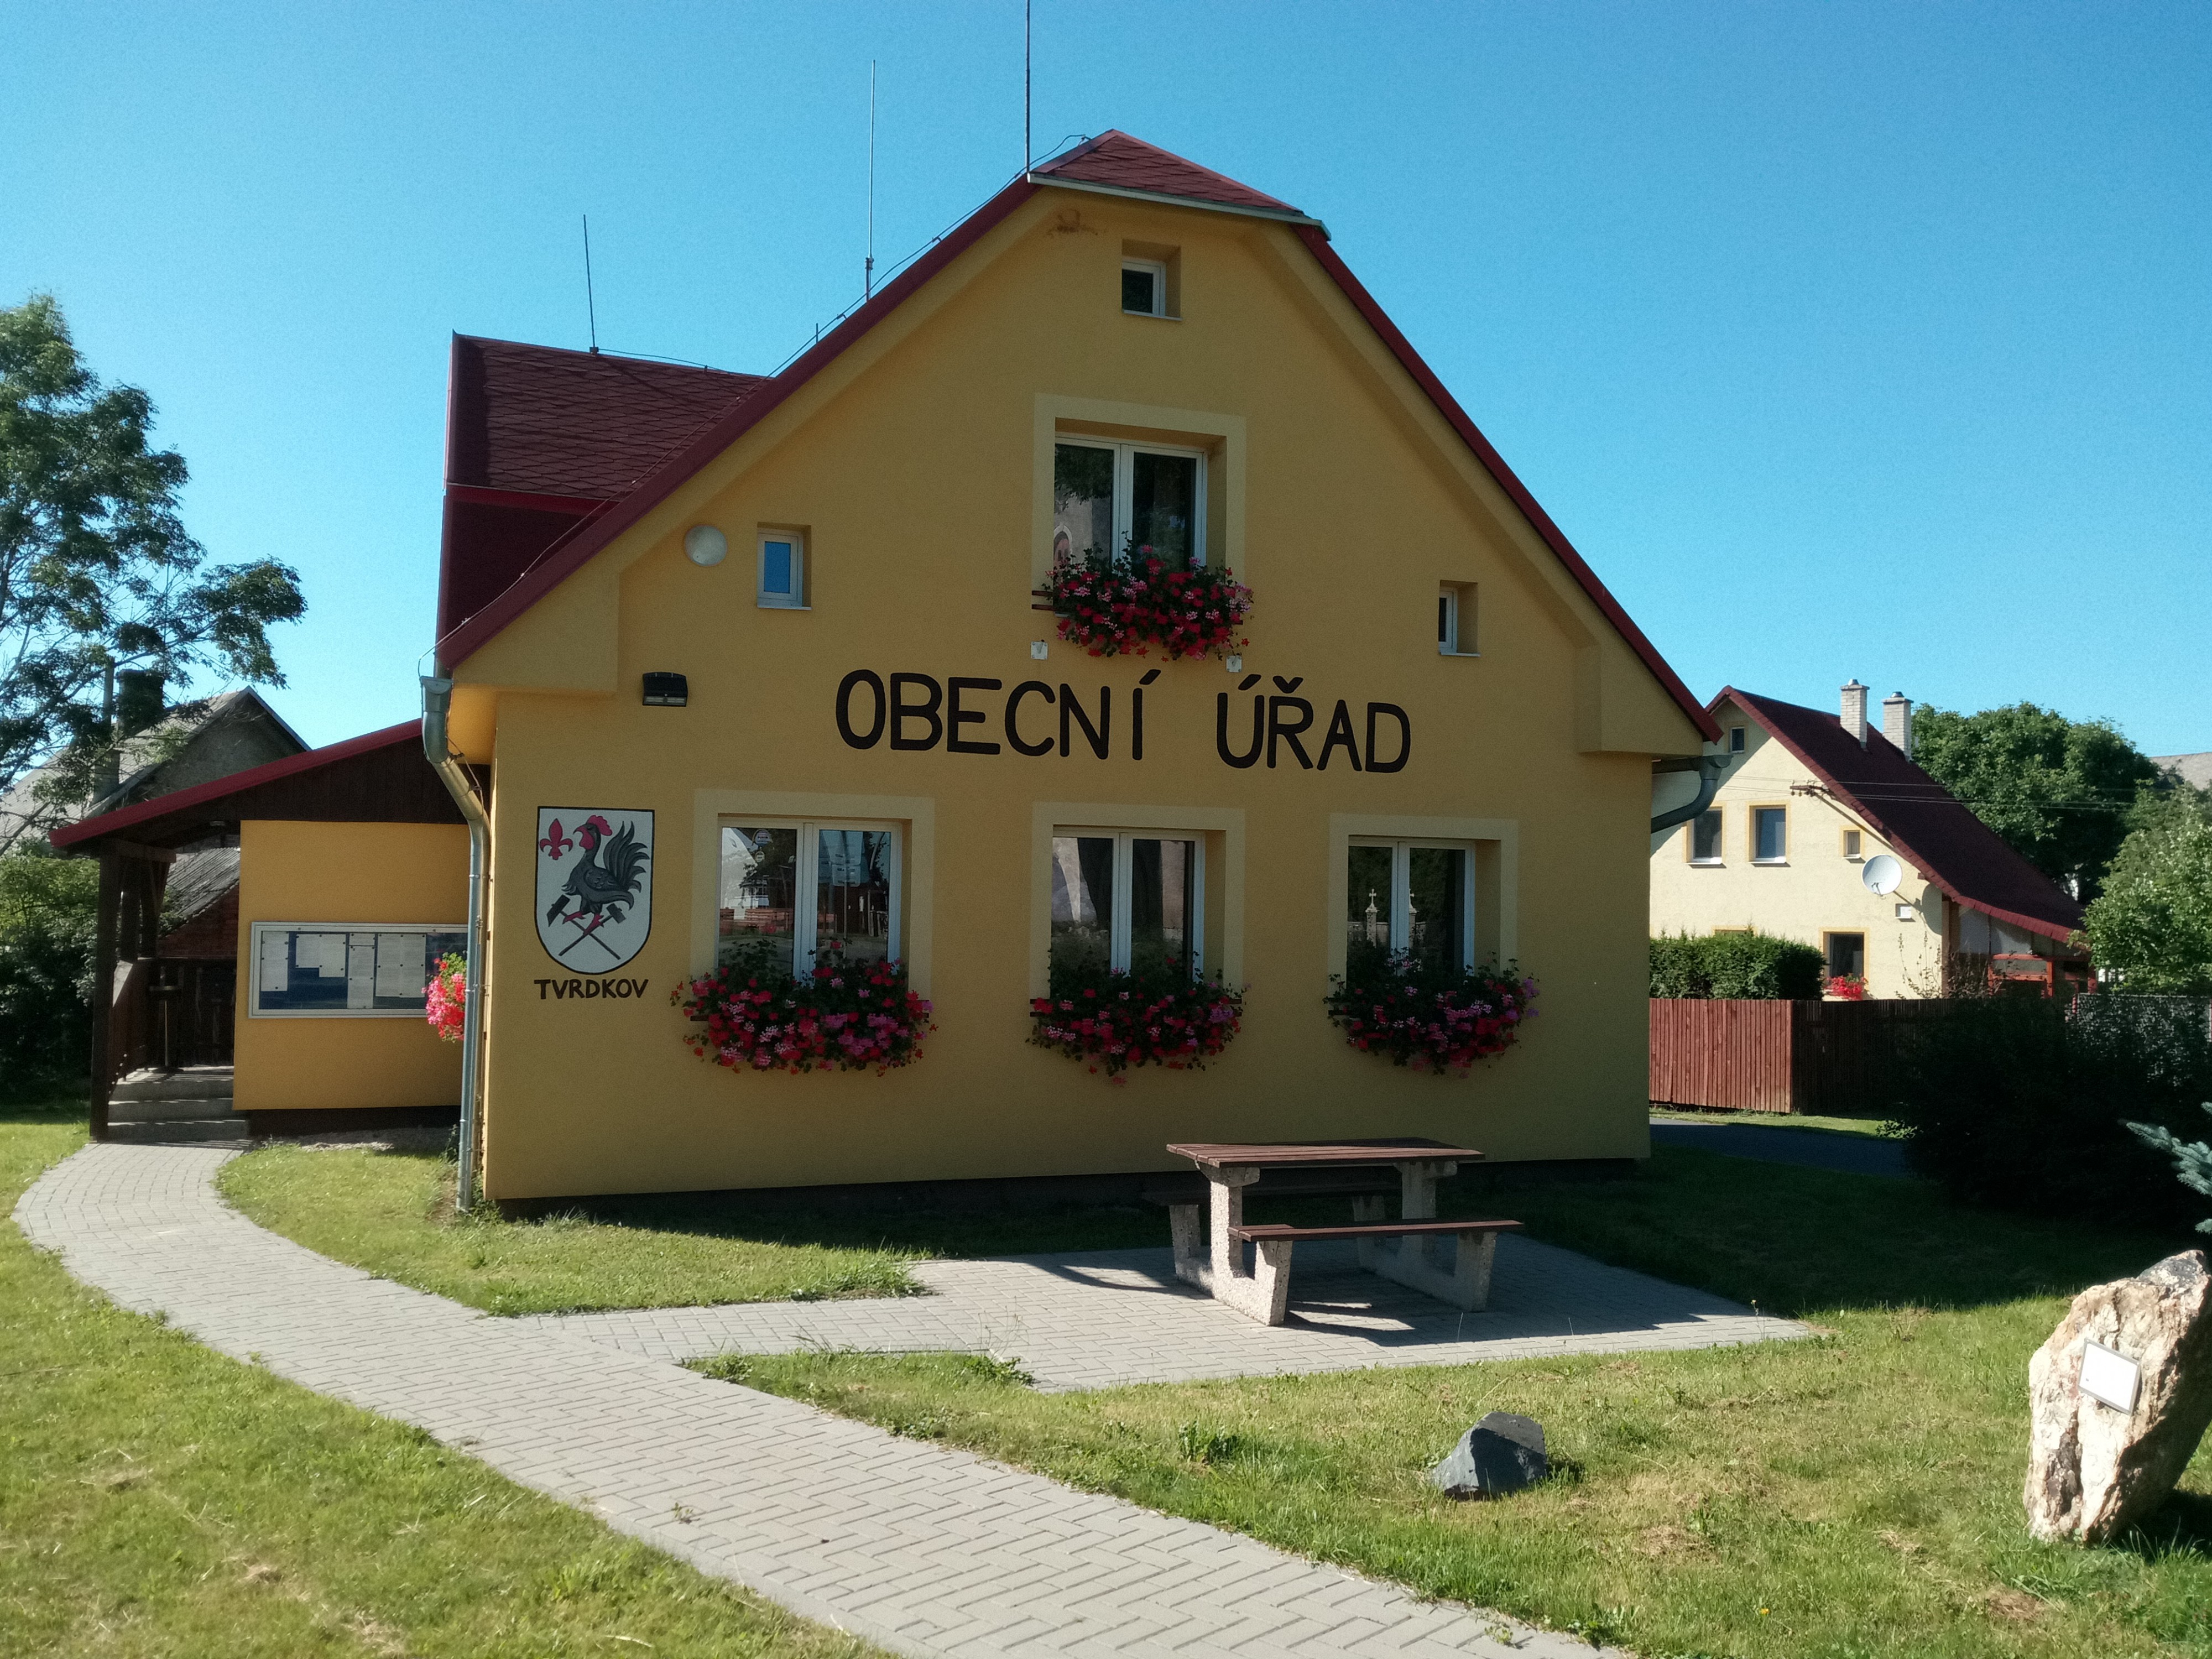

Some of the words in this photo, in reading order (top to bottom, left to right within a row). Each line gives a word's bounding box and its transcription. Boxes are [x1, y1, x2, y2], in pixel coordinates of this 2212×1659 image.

[834, 668, 1162, 761] OBECNÍ
[1215, 673, 1412, 774] ÚŘAD
[533, 978, 650, 1000] TVRDKOV
